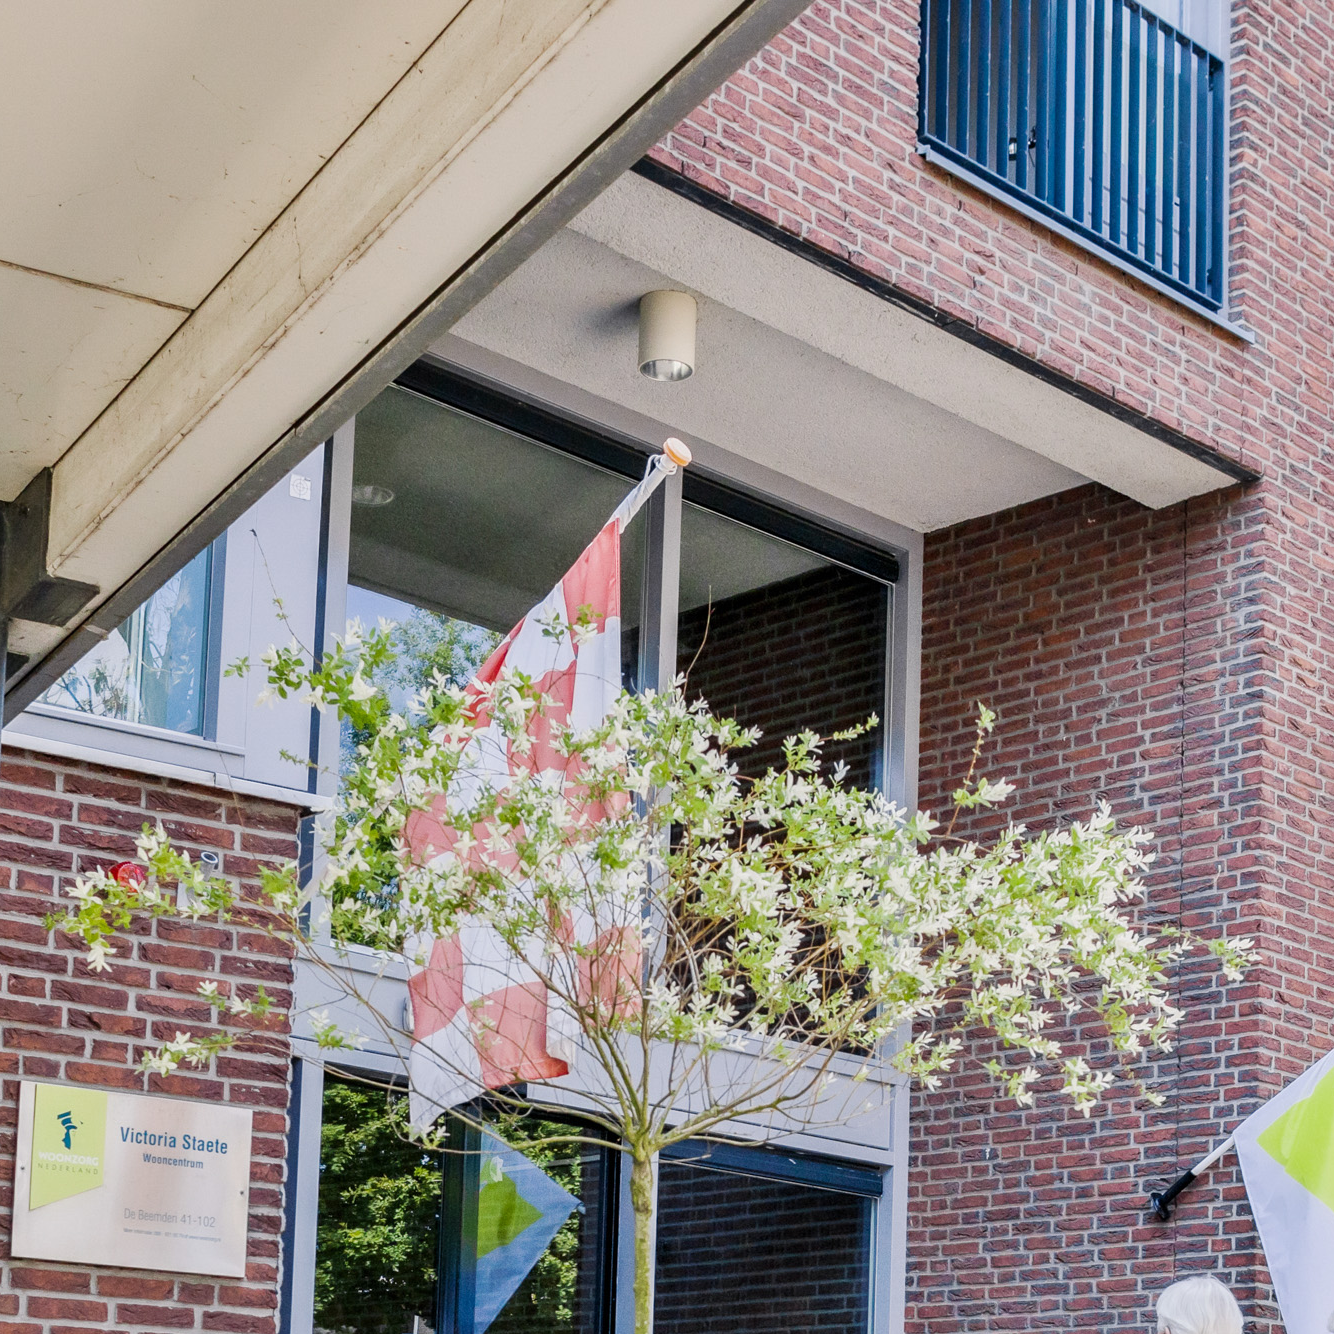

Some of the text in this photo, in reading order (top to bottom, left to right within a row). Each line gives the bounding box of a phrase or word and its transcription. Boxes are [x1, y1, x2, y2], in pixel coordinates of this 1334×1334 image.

[120, 1126, 228, 1154] Victoria Staete
[38, 1151, 99, 1167] WOONZORG
[142, 1152, 204, 1169] Wooncentrum
[37, 1162, 99, 1175] NEDERLAND
[124, 1207, 216, 1228] De Beemden 41-102
